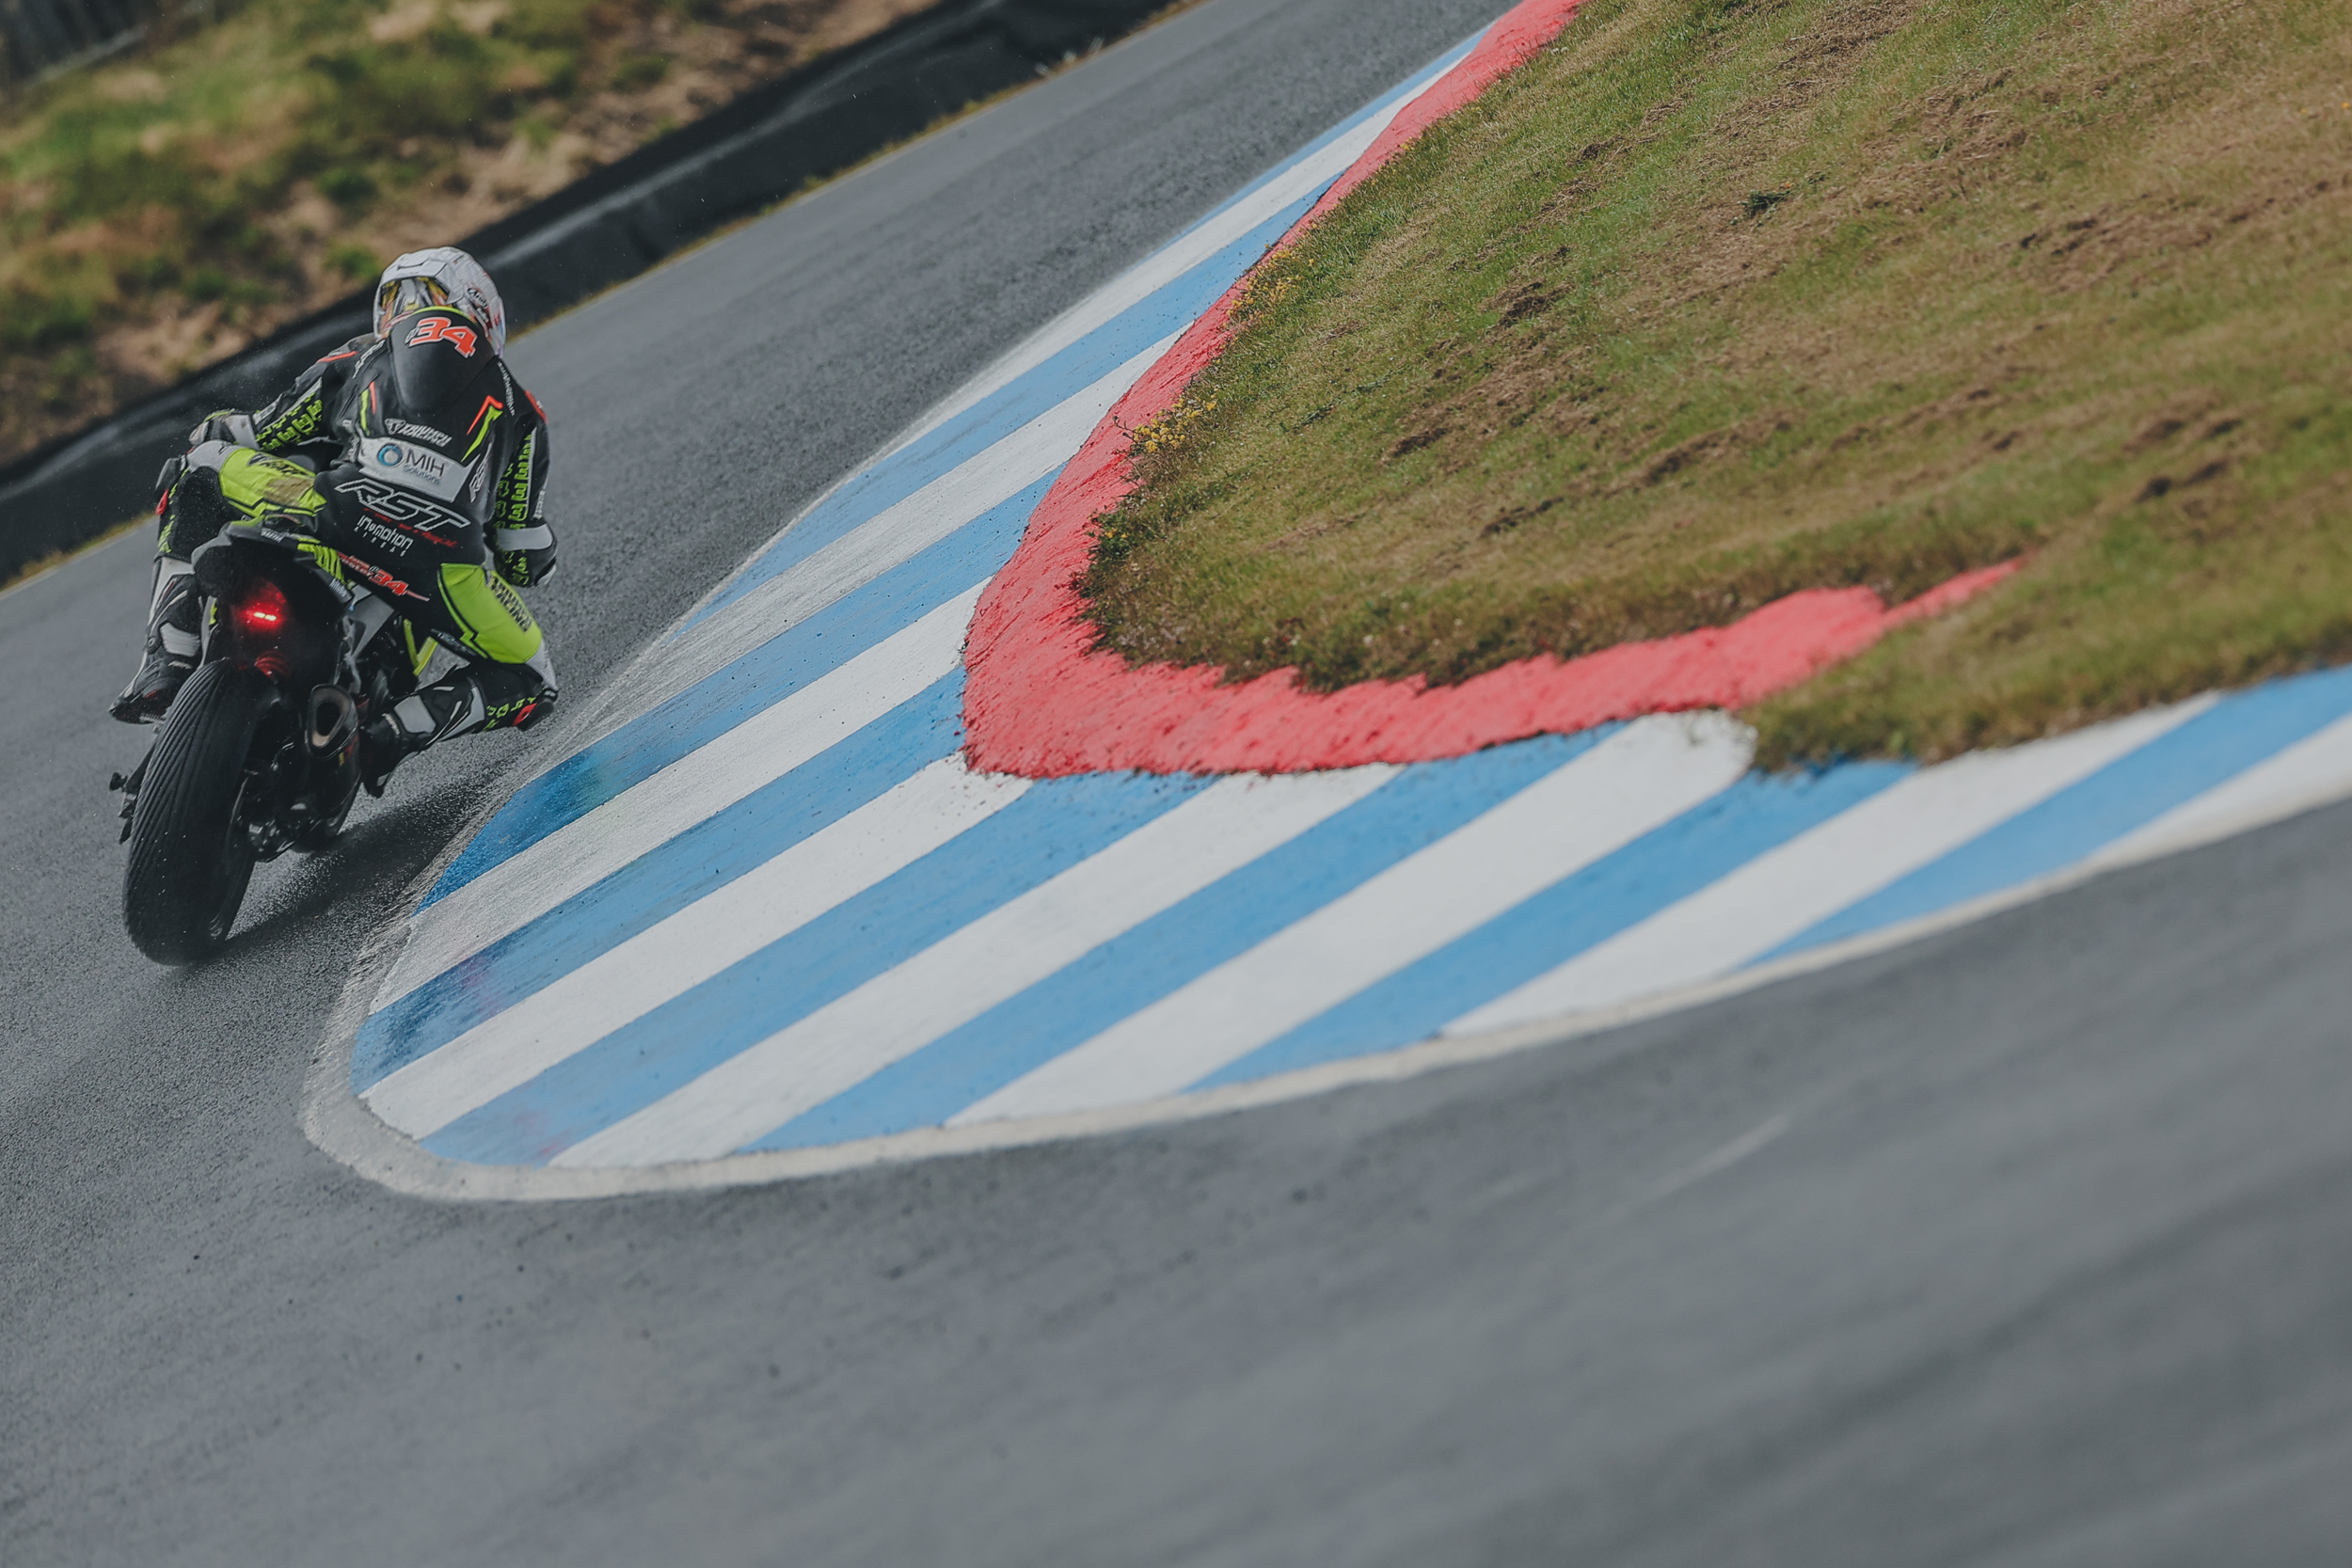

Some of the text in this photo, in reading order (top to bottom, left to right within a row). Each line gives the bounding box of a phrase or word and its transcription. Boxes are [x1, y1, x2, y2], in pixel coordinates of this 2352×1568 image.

[408, 316, 478, 358] 34
[403, 464, 441, 484] Solutions
[405, 448, 445, 477] MIH
[334, 478, 471, 532] RST
[368, 568, 409, 596] 34
